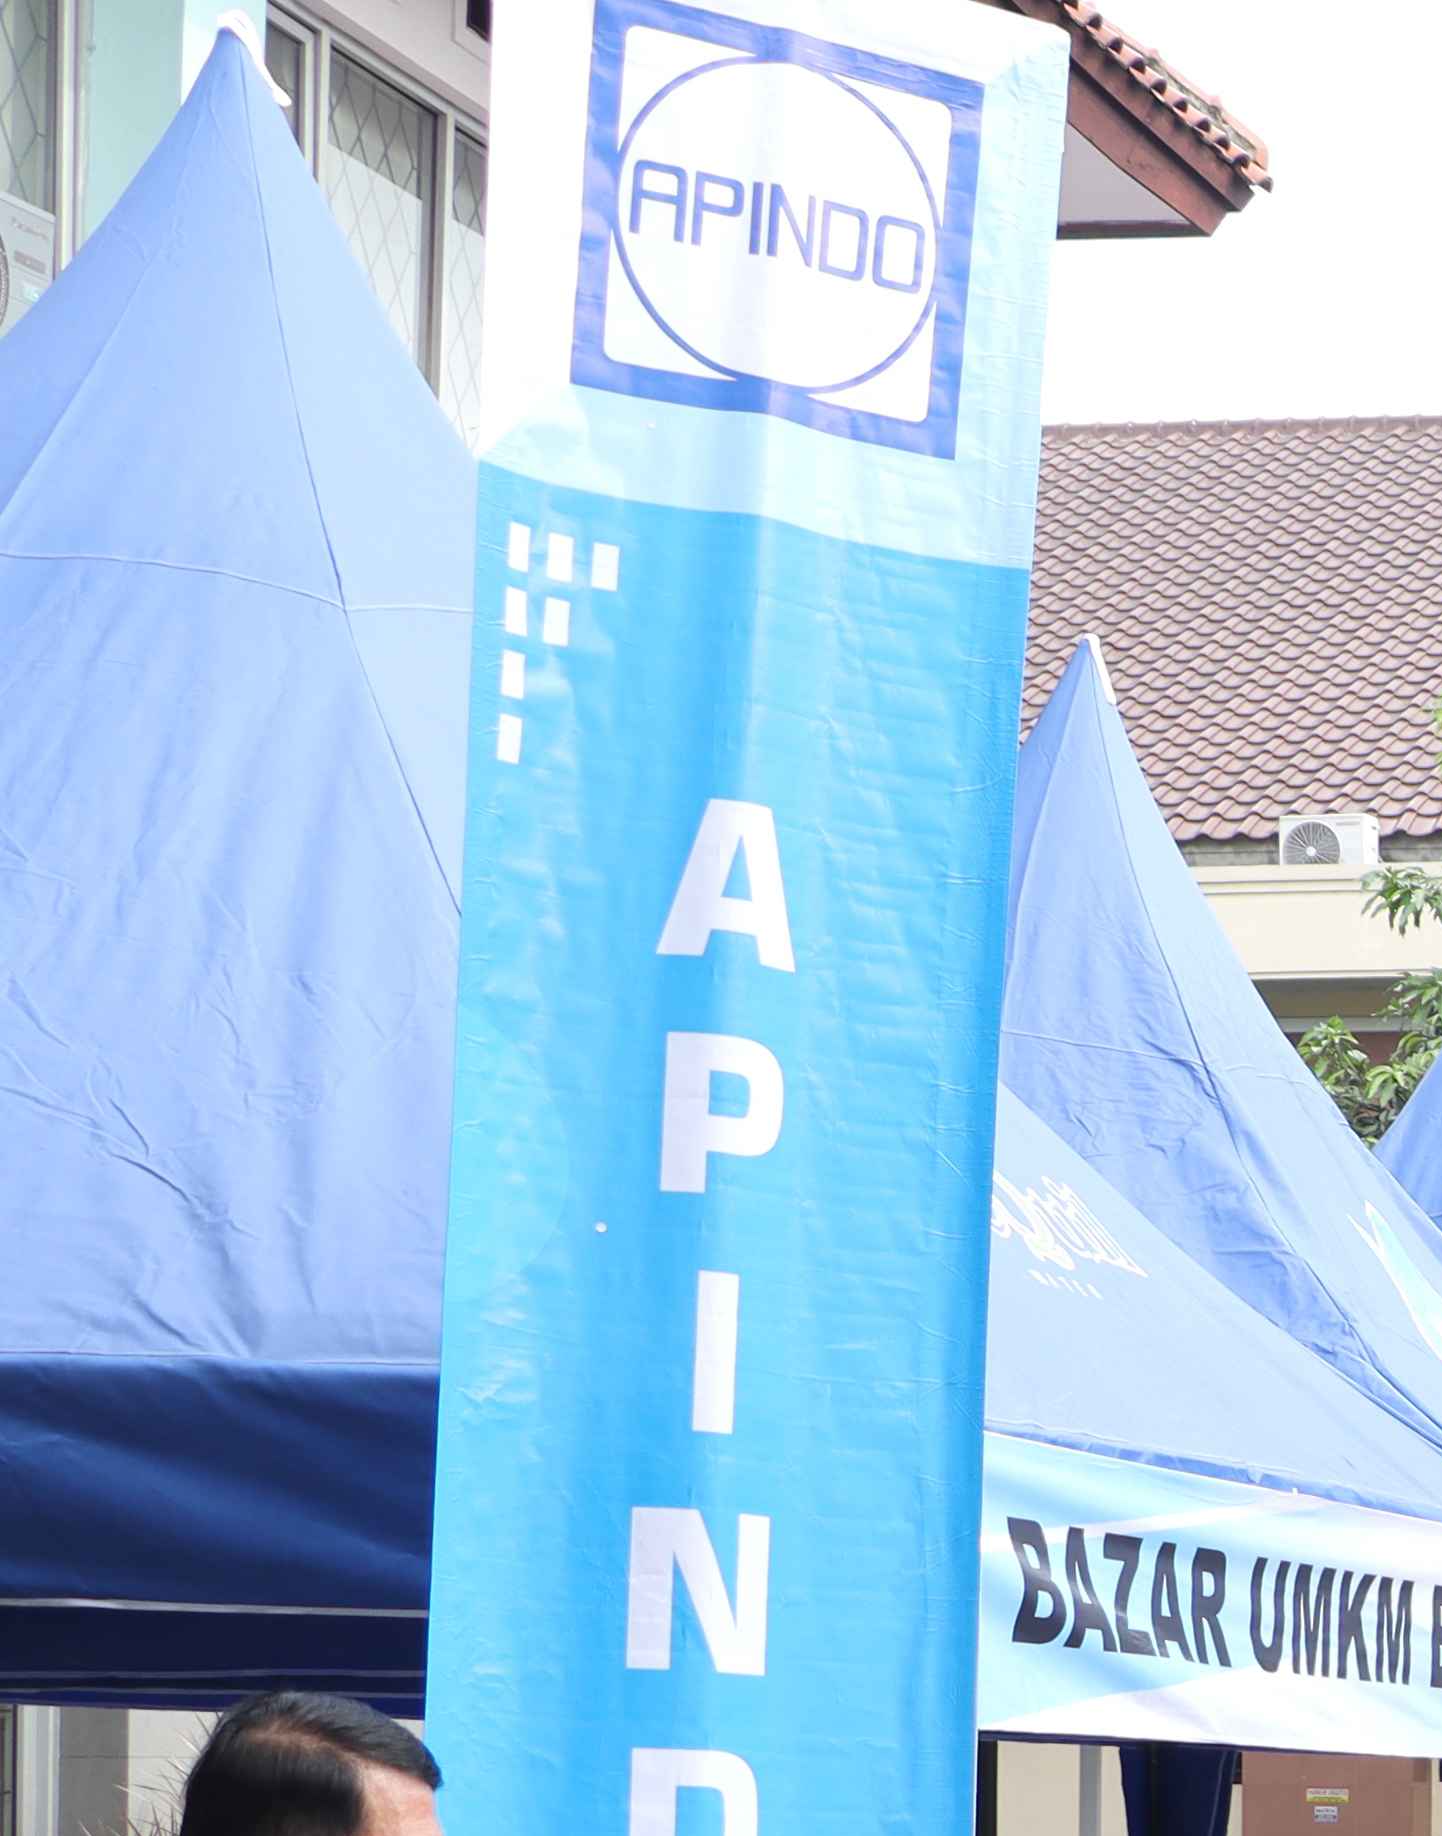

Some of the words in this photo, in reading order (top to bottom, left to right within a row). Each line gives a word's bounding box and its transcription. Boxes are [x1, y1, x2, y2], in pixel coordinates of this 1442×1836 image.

[629, 159, 926, 294] APINDO
[1007, 1517, 1232, 1667] BAZAR
[1248, 1556, 1415, 1686] UMKM
